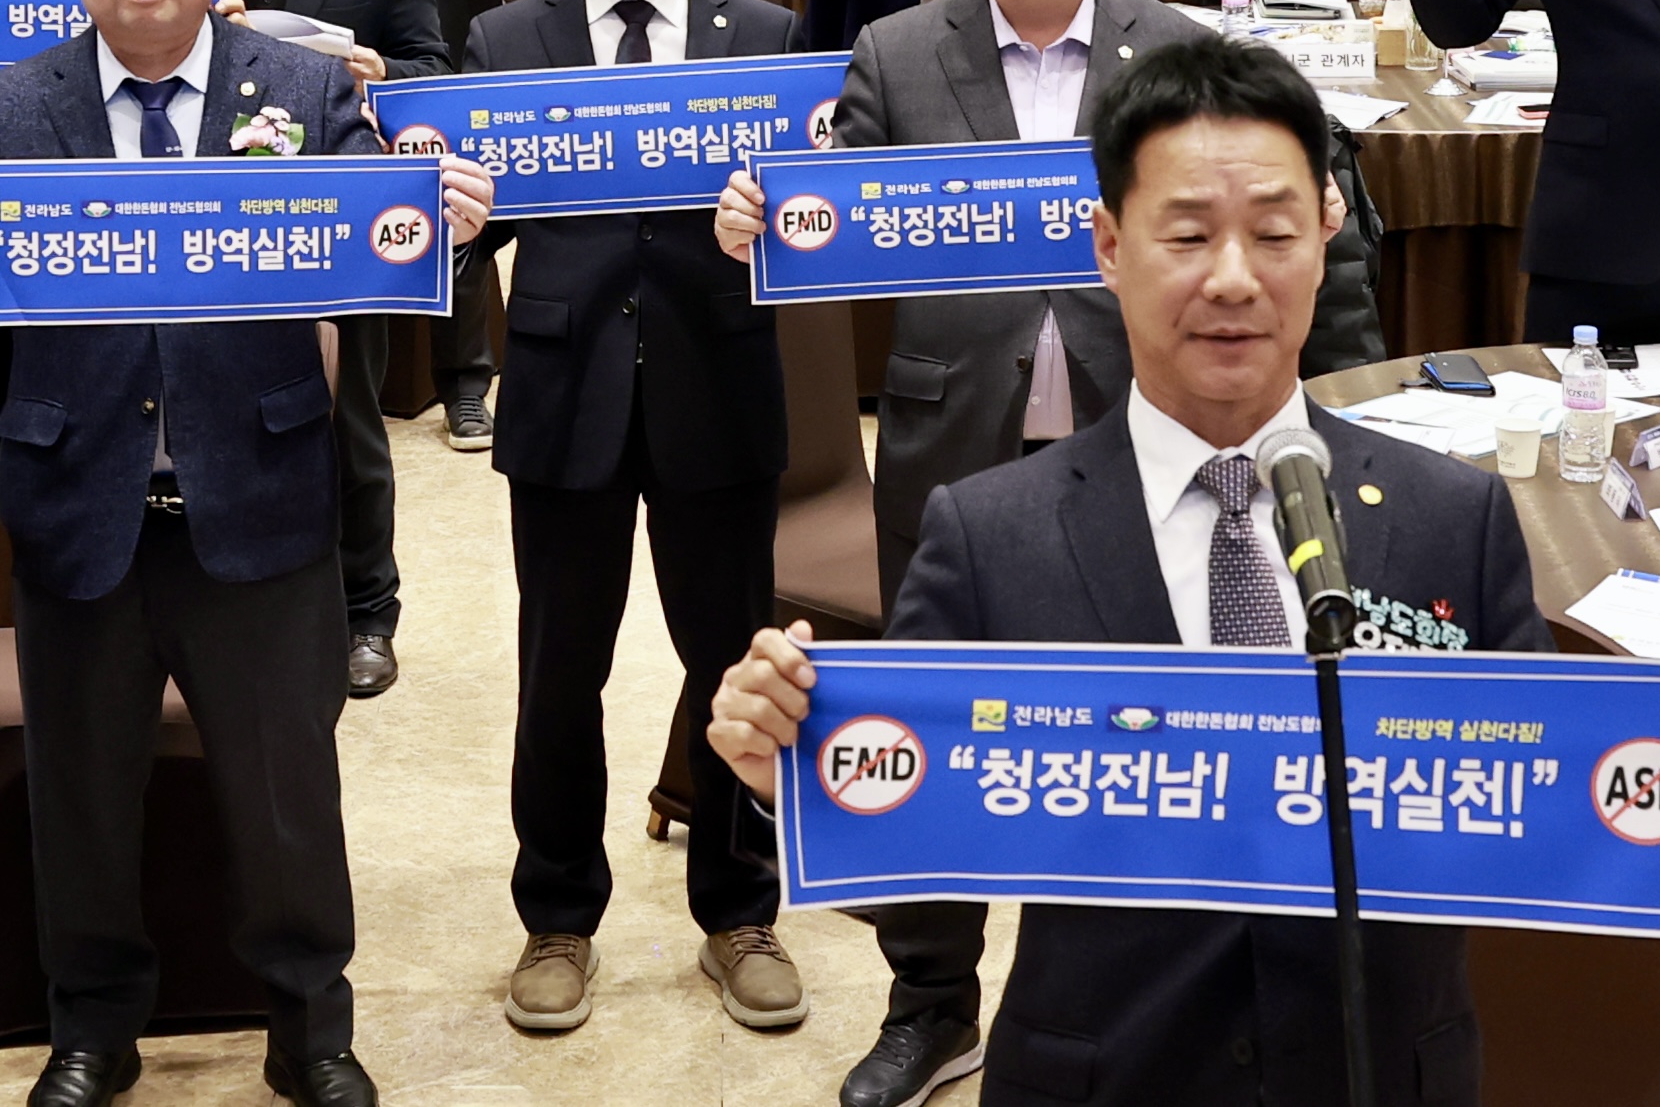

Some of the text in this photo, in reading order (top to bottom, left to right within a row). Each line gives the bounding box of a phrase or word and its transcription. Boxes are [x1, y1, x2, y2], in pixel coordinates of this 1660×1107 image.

[1291, 53, 1365, 67] 군 관계자
[492, 95, 776, 124] 전라남도 전남도협의회 차단방역 실천다짐!
[885, 175, 1078, 195] 전라남도 전남도협의회
[25, 199, 338, 217] 전라남도 대한한돈협회 전남도협의회 차단방역 실천다짐!
[784, 210, 832, 234] FMD
[378, 222, 421, 247] ASF
[1351, 585, 1469, 651] 남도회장
[1013, 706, 1093, 727] 전라남도
[1166, 712, 1322, 732] 대한한돈협회 전남도협
[1377, 717, 1543, 744] 차단방역 실천다짐!
[832, 746, 915, 782] FMD
